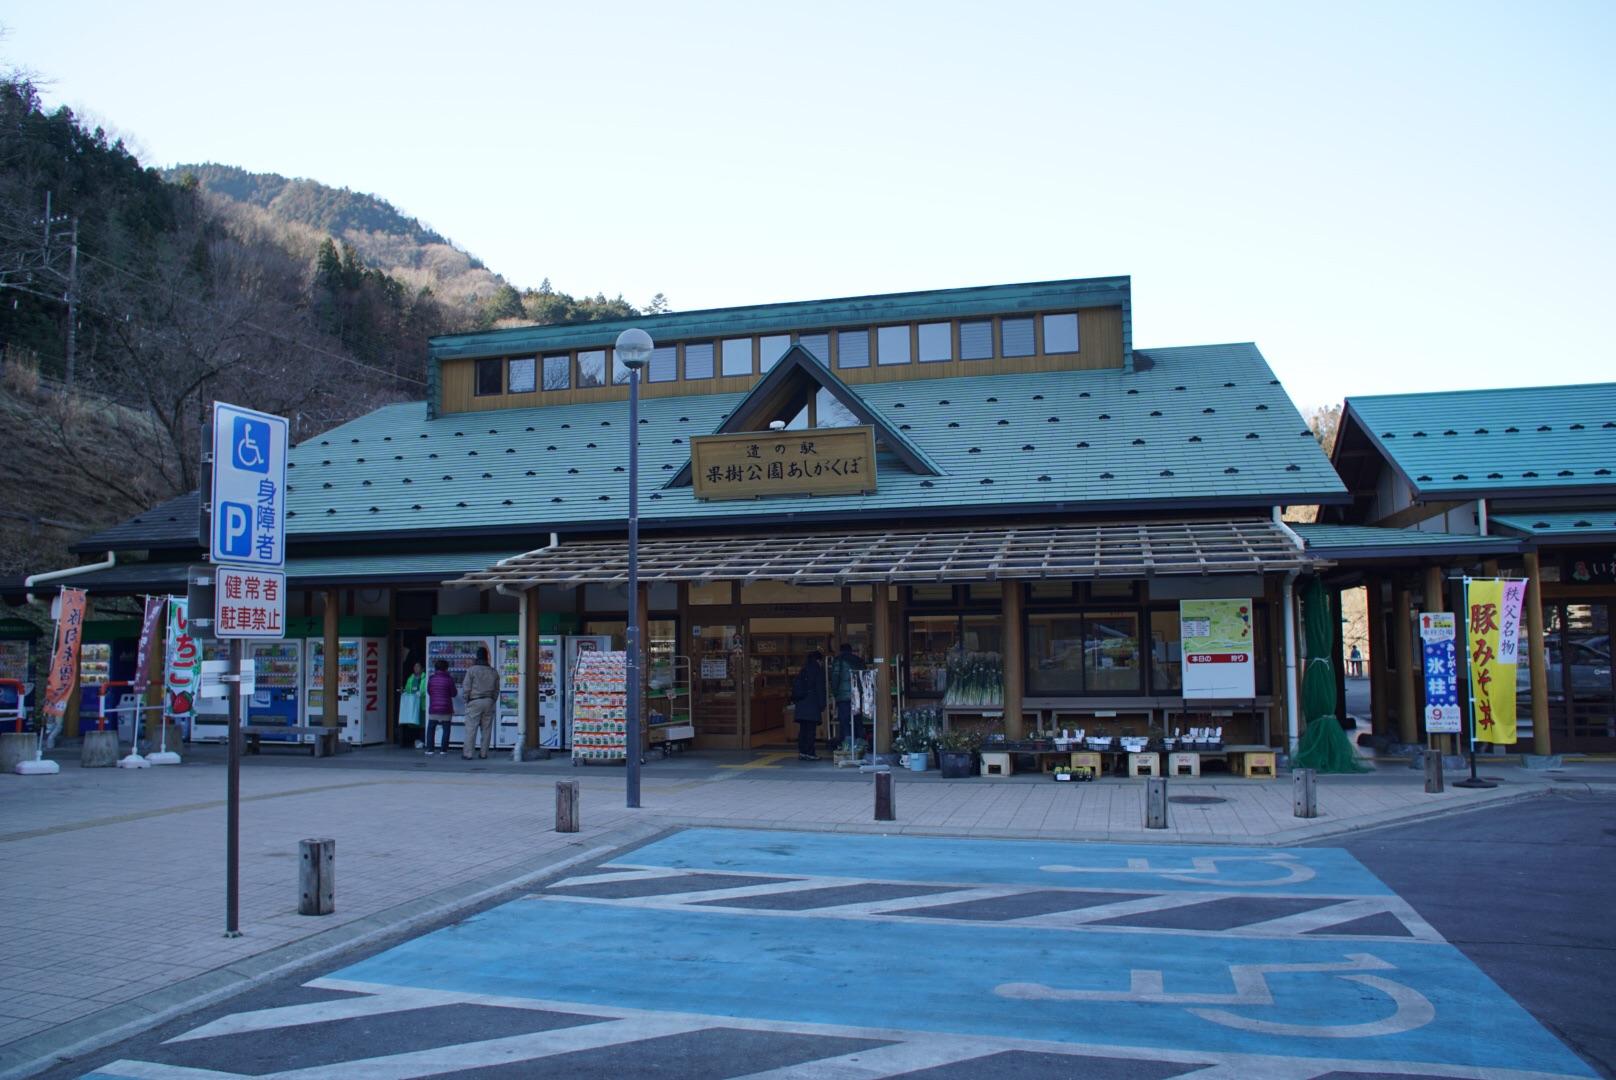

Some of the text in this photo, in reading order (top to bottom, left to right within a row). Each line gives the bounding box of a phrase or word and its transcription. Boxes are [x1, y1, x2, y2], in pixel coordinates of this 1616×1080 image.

[706, 456, 863, 484] 果樹公園あしがくぼ
[746, 441, 817, 459] 道の駅
[225, 507, 247, 551] P
[256, 478, 276, 560] 身障者
[225, 575, 279, 601] 健常者
[220, 606, 281, 632] 駐車禁止
[1501, 586, 1521, 656] 秩父名物
[170, 607, 197, 685] いちご
[1469, 603, 1499, 731] 豚みそ丼
[366, 641, 378, 712] KIRIN
[1427, 657, 1447, 695] 氷柱
